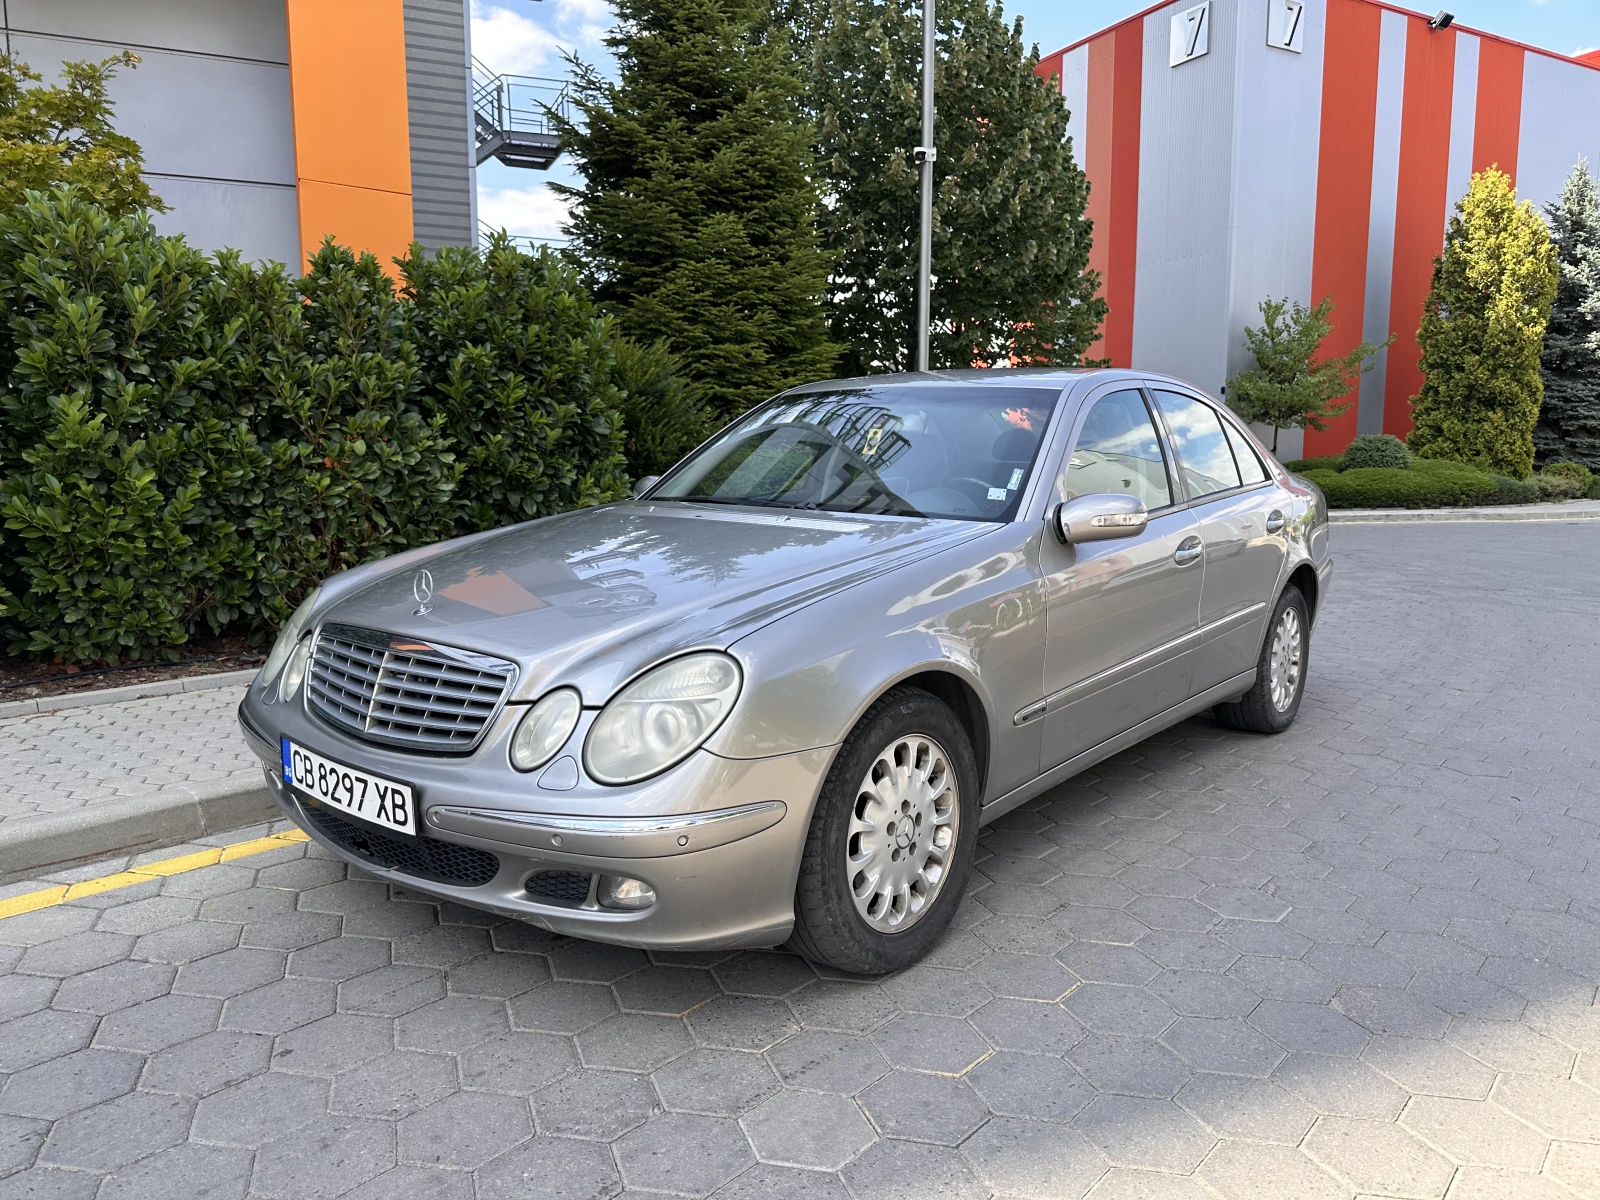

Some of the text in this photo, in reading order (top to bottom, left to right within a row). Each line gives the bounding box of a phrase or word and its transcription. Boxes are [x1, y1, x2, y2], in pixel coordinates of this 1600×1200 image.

[1185, 6, 1206, 57] 7
[1283, 0, 1302, 47] 7
[293, 749, 409, 827] CB 8297 XB
